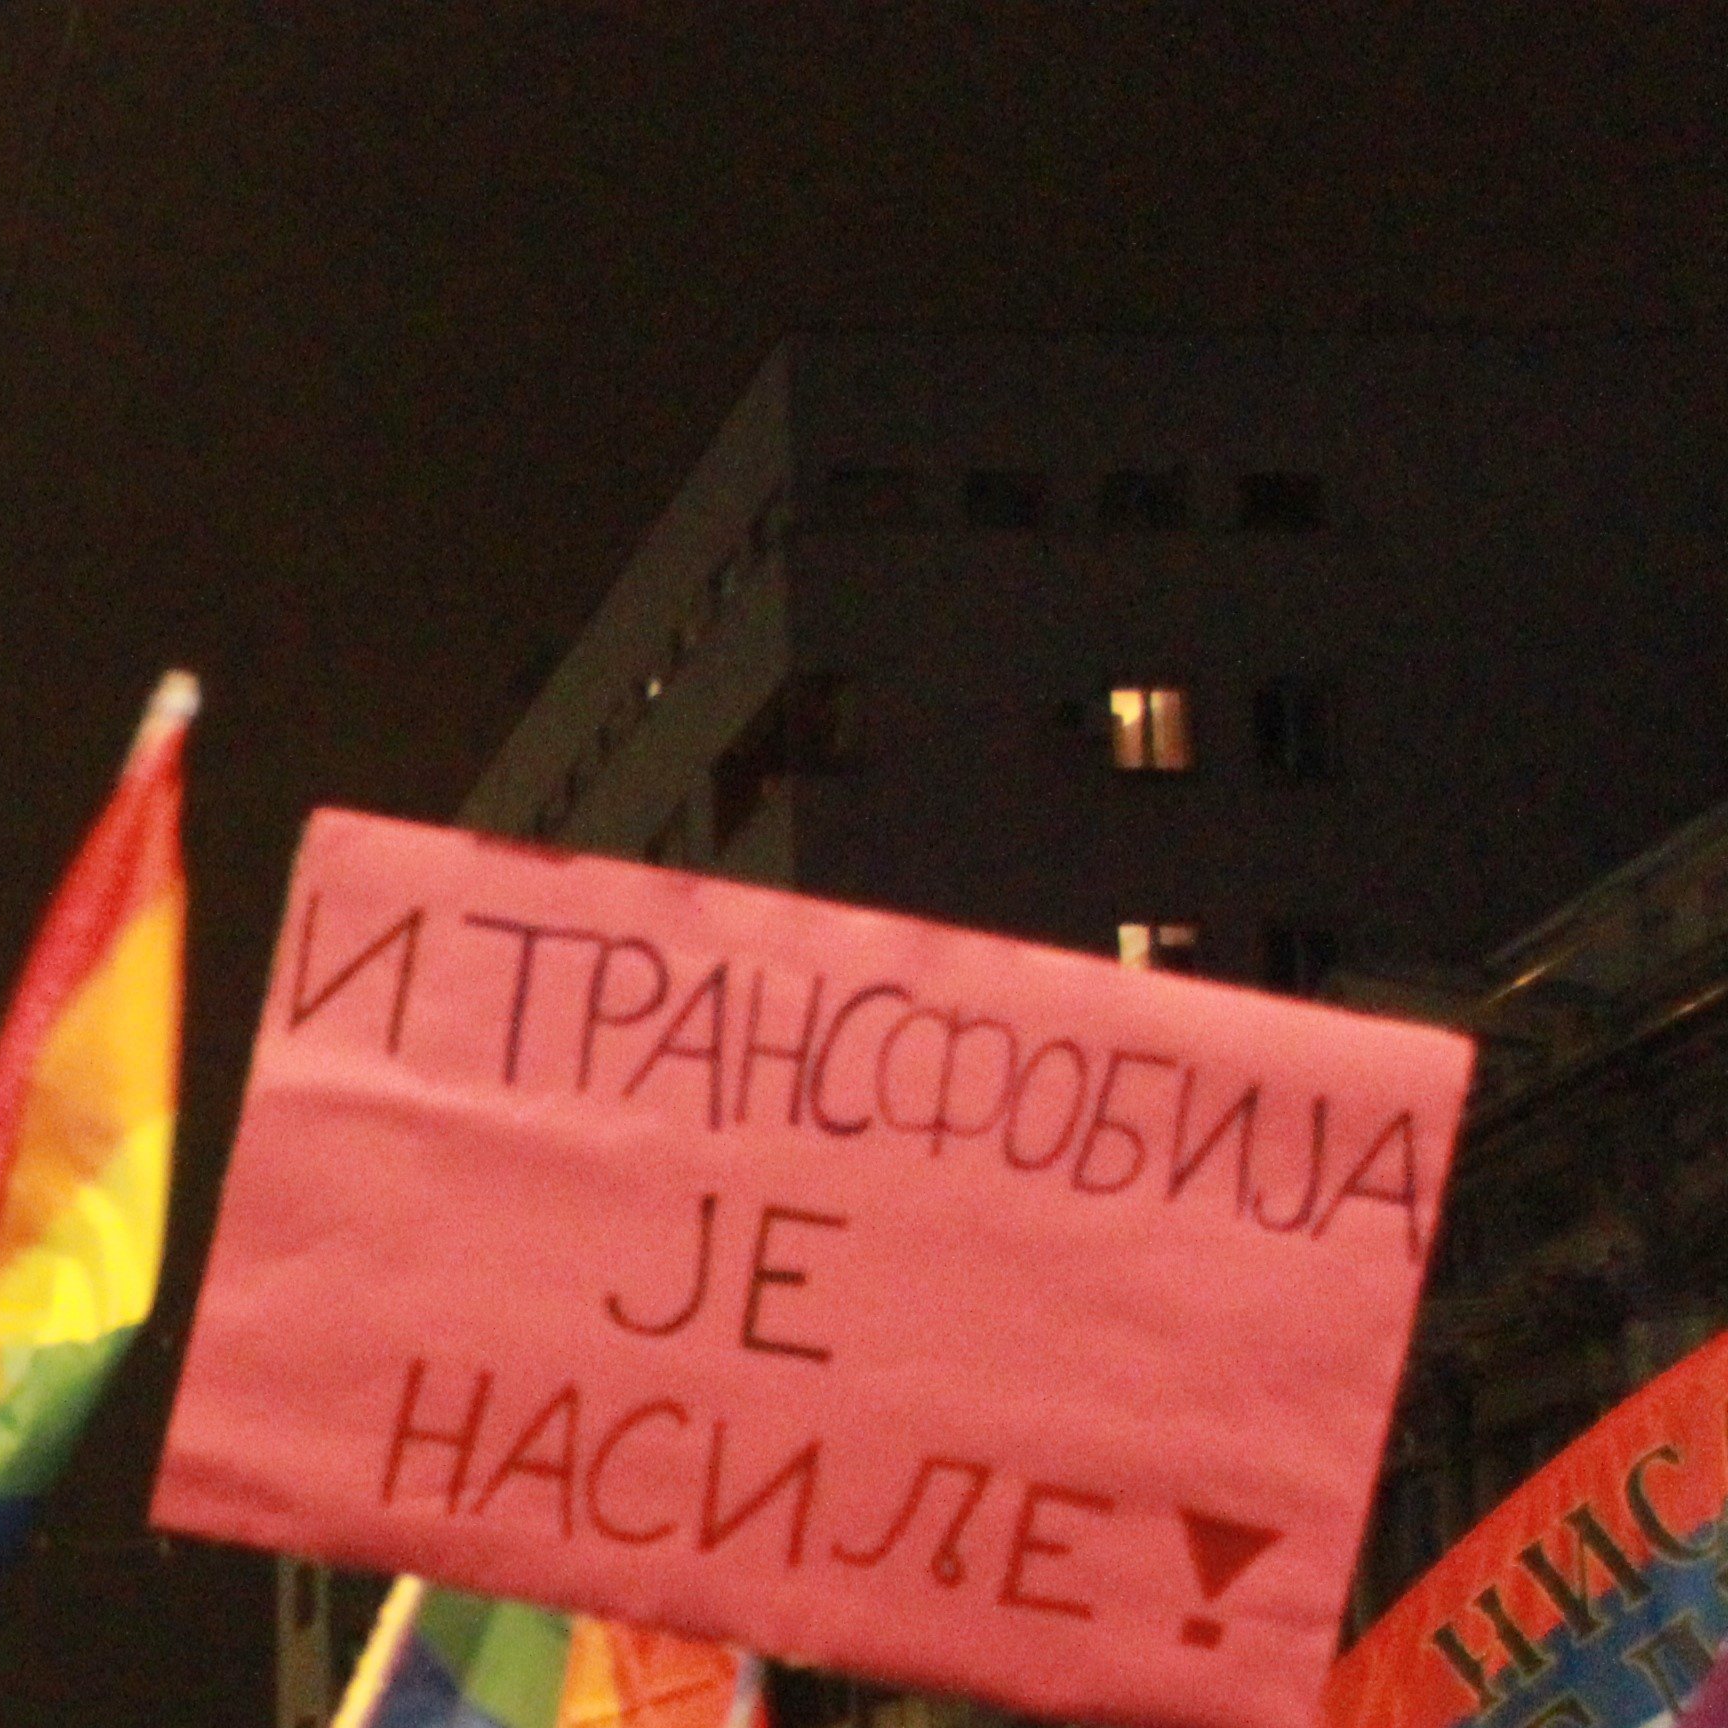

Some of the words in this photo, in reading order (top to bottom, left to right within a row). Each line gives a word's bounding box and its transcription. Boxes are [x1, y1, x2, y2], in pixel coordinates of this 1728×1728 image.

[284, 890, 428, 1057] И
[461, 909, 1434, 1256] ТРАНСФОБИЈА
[604, 1191, 849, 1364] ЈЕ
